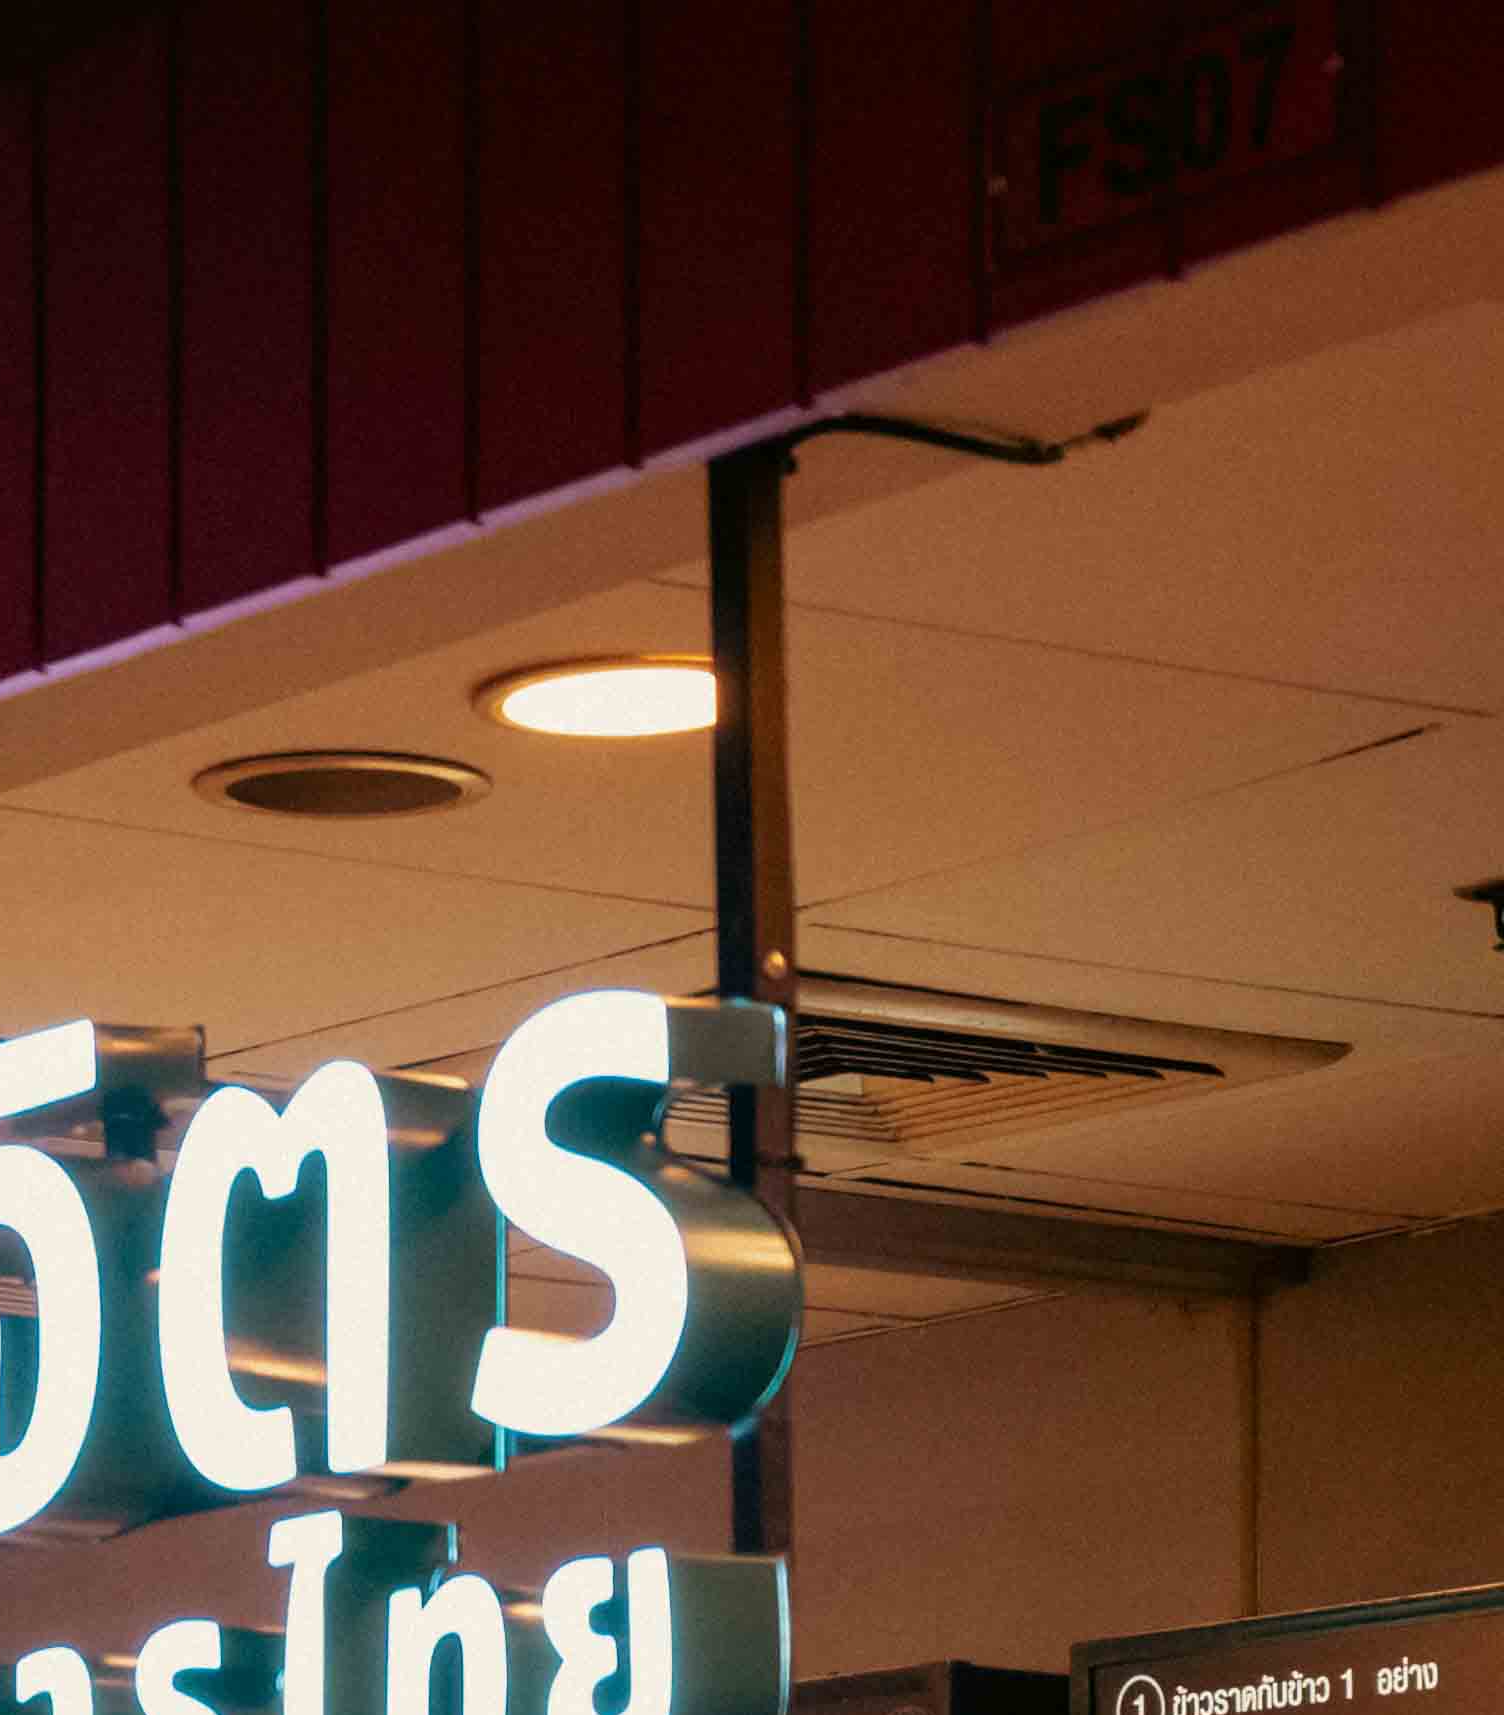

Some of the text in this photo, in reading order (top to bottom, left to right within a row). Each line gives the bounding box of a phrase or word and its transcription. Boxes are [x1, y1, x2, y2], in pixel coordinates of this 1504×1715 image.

[1039, 25, 1296, 224] FS07
[1340, 1668, 1353, 1700] 1
[1377, 1657, 1438, 1695] อย่าง
